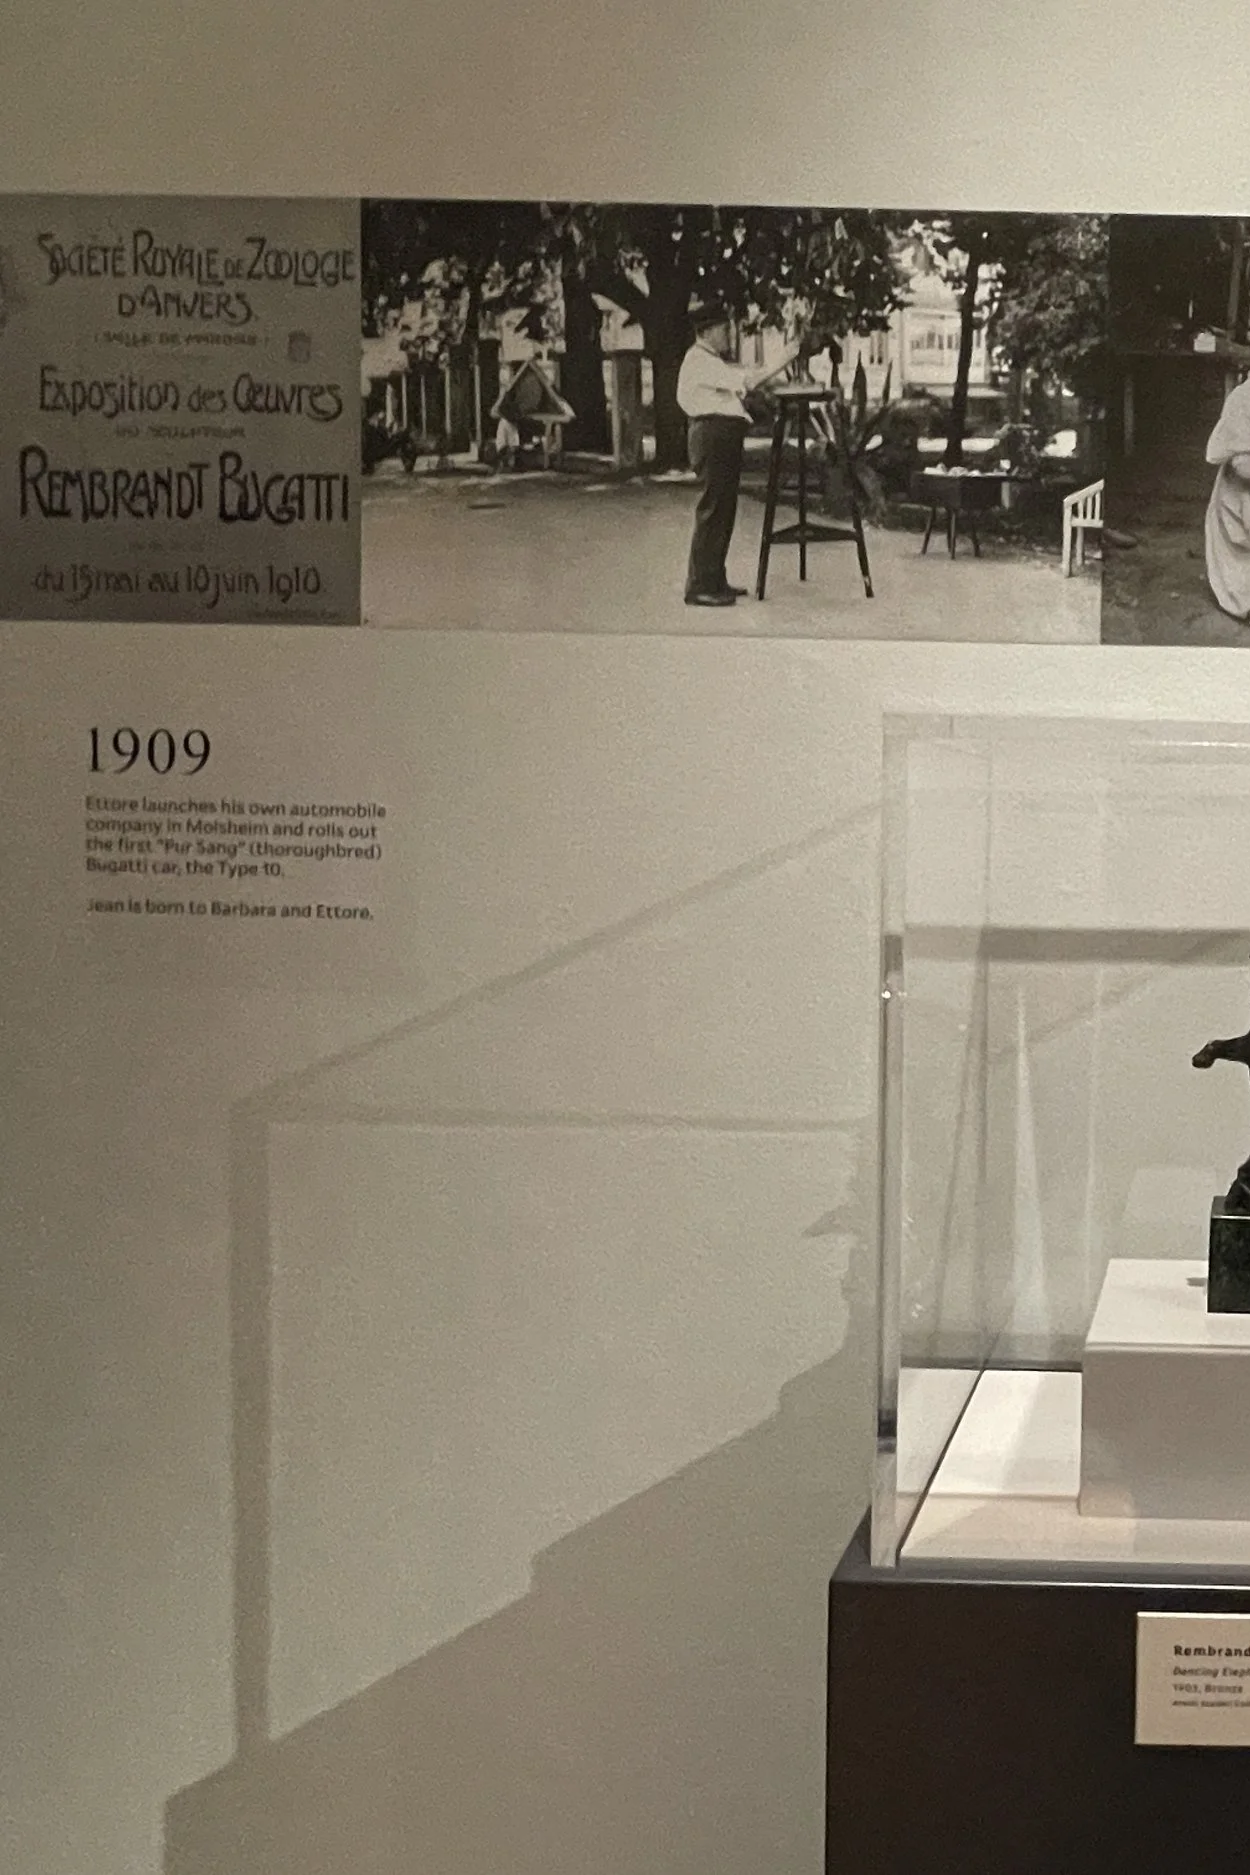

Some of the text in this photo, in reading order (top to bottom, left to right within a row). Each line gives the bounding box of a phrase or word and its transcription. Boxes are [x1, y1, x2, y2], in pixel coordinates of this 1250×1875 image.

[39, 365, 180, 418] Exposition
[187, 384, 227, 412] des
[19, 445, 350, 525] REMBRANDT BUGATTI
[35, 564, 65, 592] du
[264, 565, 321, 604] 1910
[88, 727, 212, 776] 1909
[85, 796, 386, 818] Ettore launches his own automobile
[85, 818, 377, 839] company in Molsheim and rolls out
[85, 837, 113, 852] the
[118, 837, 152, 853] first
[249, 843, 382, 861] (thoroughbred)
[86, 858, 148, 875] Bugatti
[152, 861, 181, 877] car,
[185, 859, 213, 874] the
[218, 861, 258, 880] Type
[128, 899, 142, 914] is
[145, 899, 185, 915] born
[189, 901, 206, 915] to
[211, 901, 276, 917] Barbara
[280, 903, 311, 918] and
[316, 904, 374, 920] Ettore.
